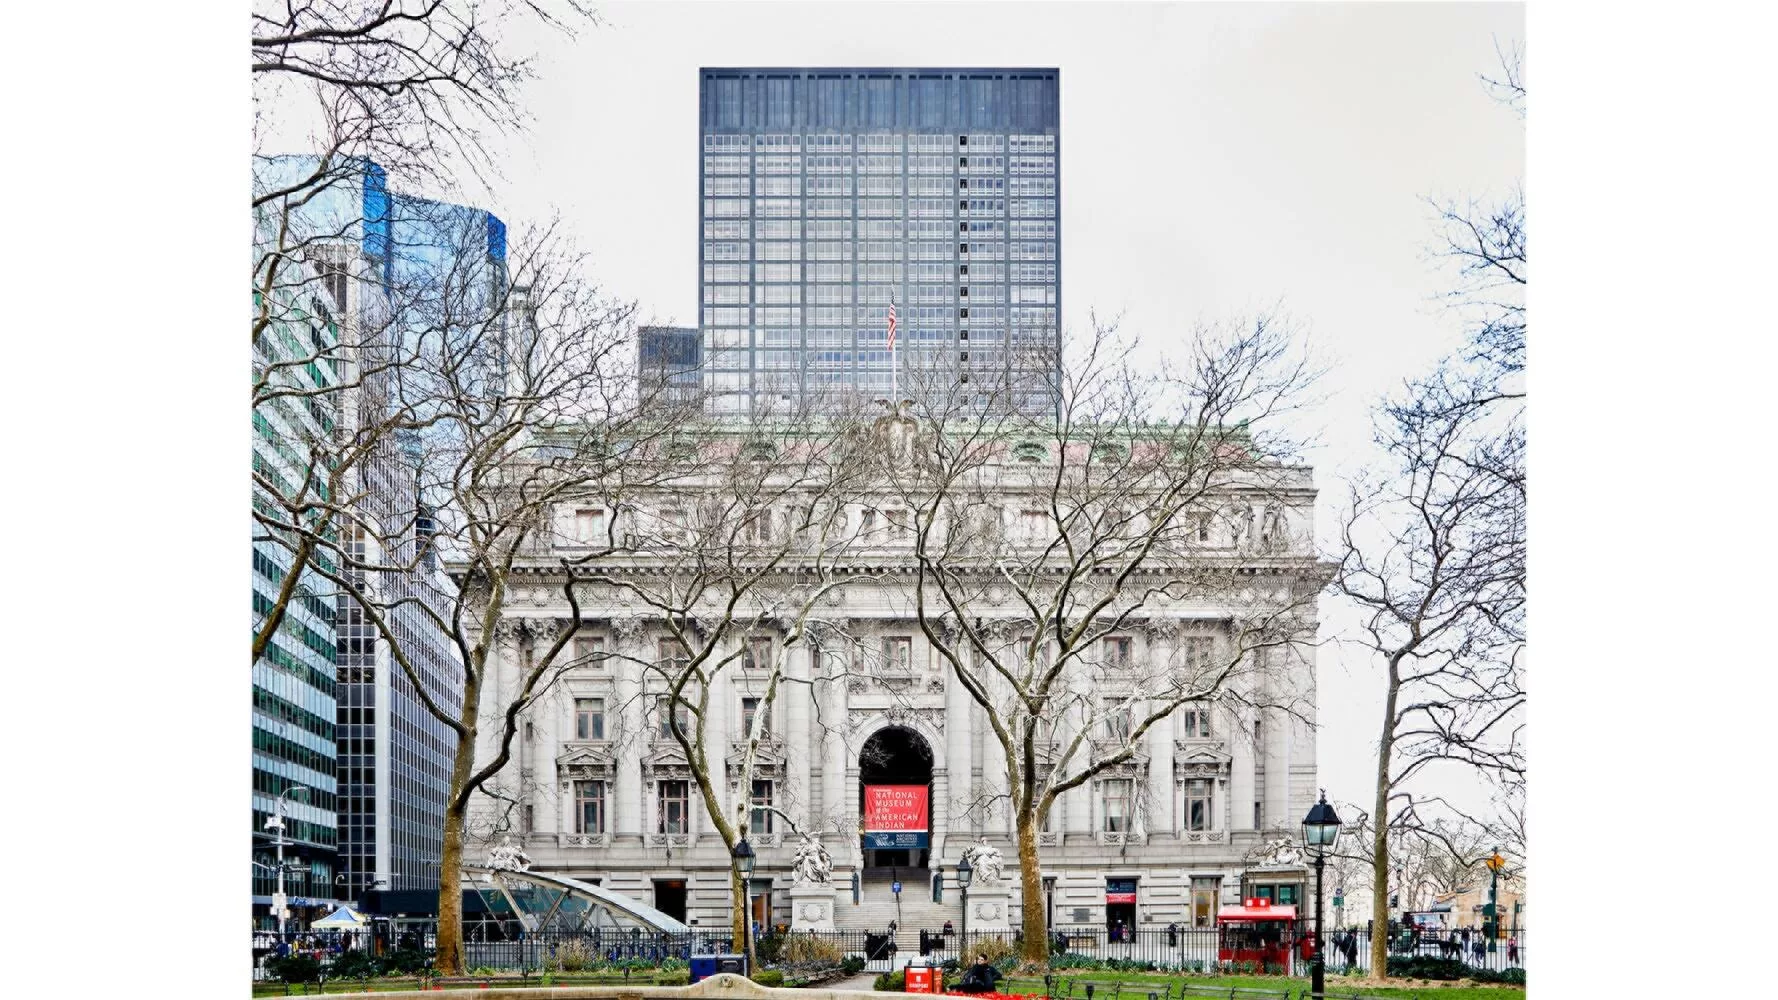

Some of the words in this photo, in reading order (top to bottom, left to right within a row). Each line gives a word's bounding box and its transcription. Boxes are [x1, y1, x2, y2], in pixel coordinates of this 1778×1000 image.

[876, 791, 917, 799] NATIONAL
[876, 799, 912, 807] MUSEUM
[876, 813, 918, 821] AMERICAN
[876, 821, 905, 829] INDIAN
